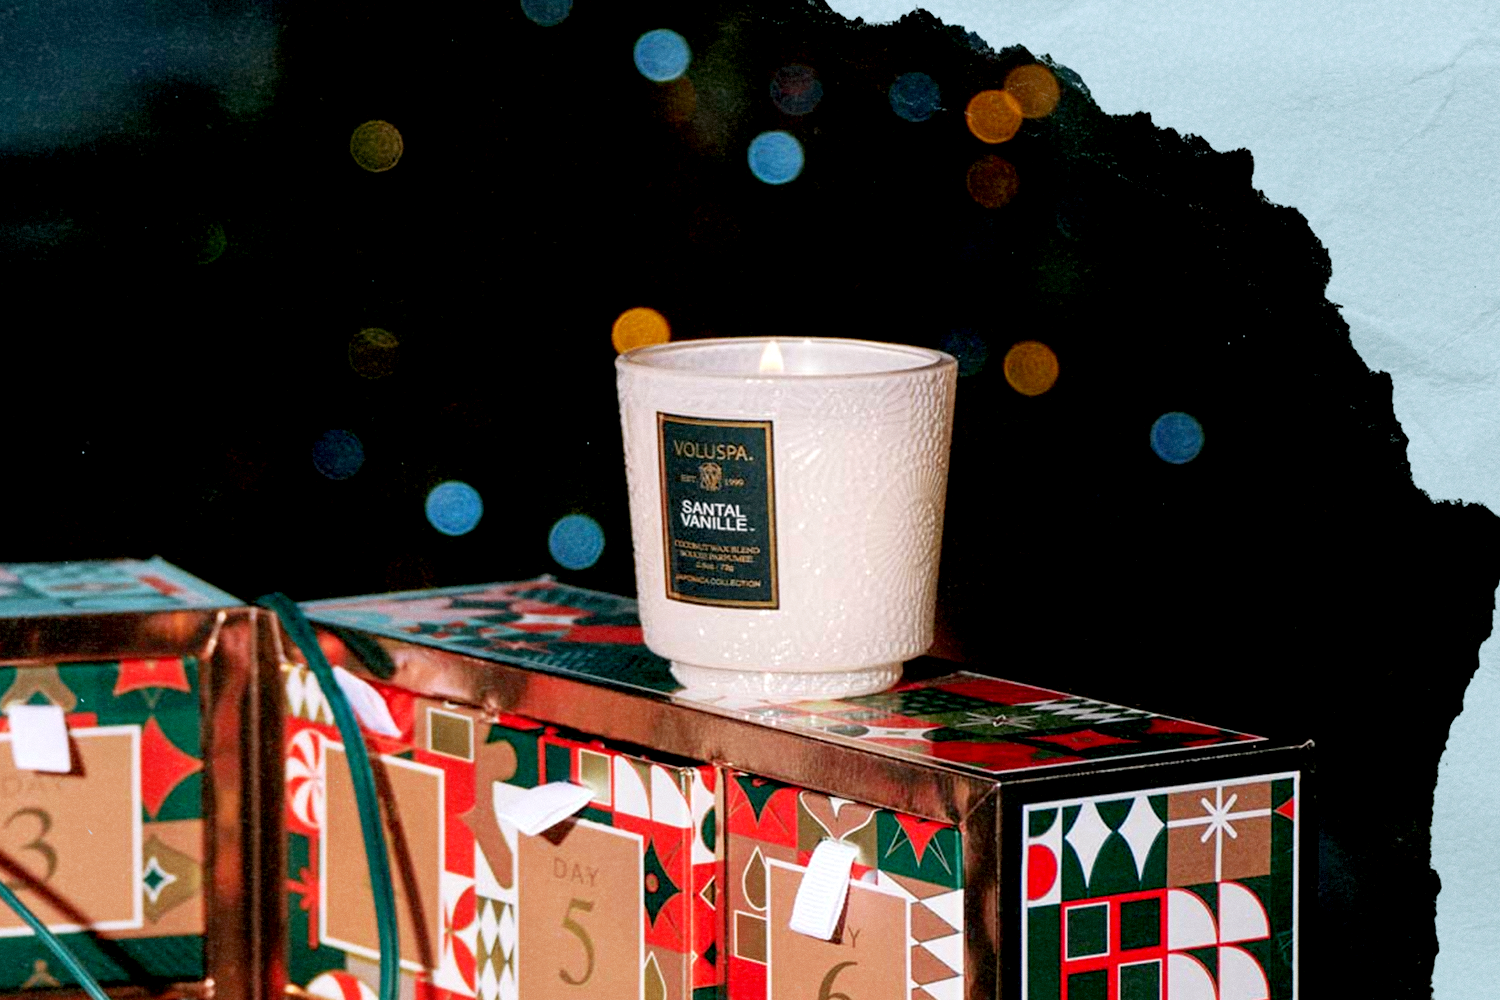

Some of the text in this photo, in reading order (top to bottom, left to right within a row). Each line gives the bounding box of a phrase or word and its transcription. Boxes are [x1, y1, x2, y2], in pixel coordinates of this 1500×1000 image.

[681, 499, 746, 518] SANTAL
[2, 804, 60, 891] 3
[553, 856, 599, 887] DAY
[558, 898, 595, 986] 5
